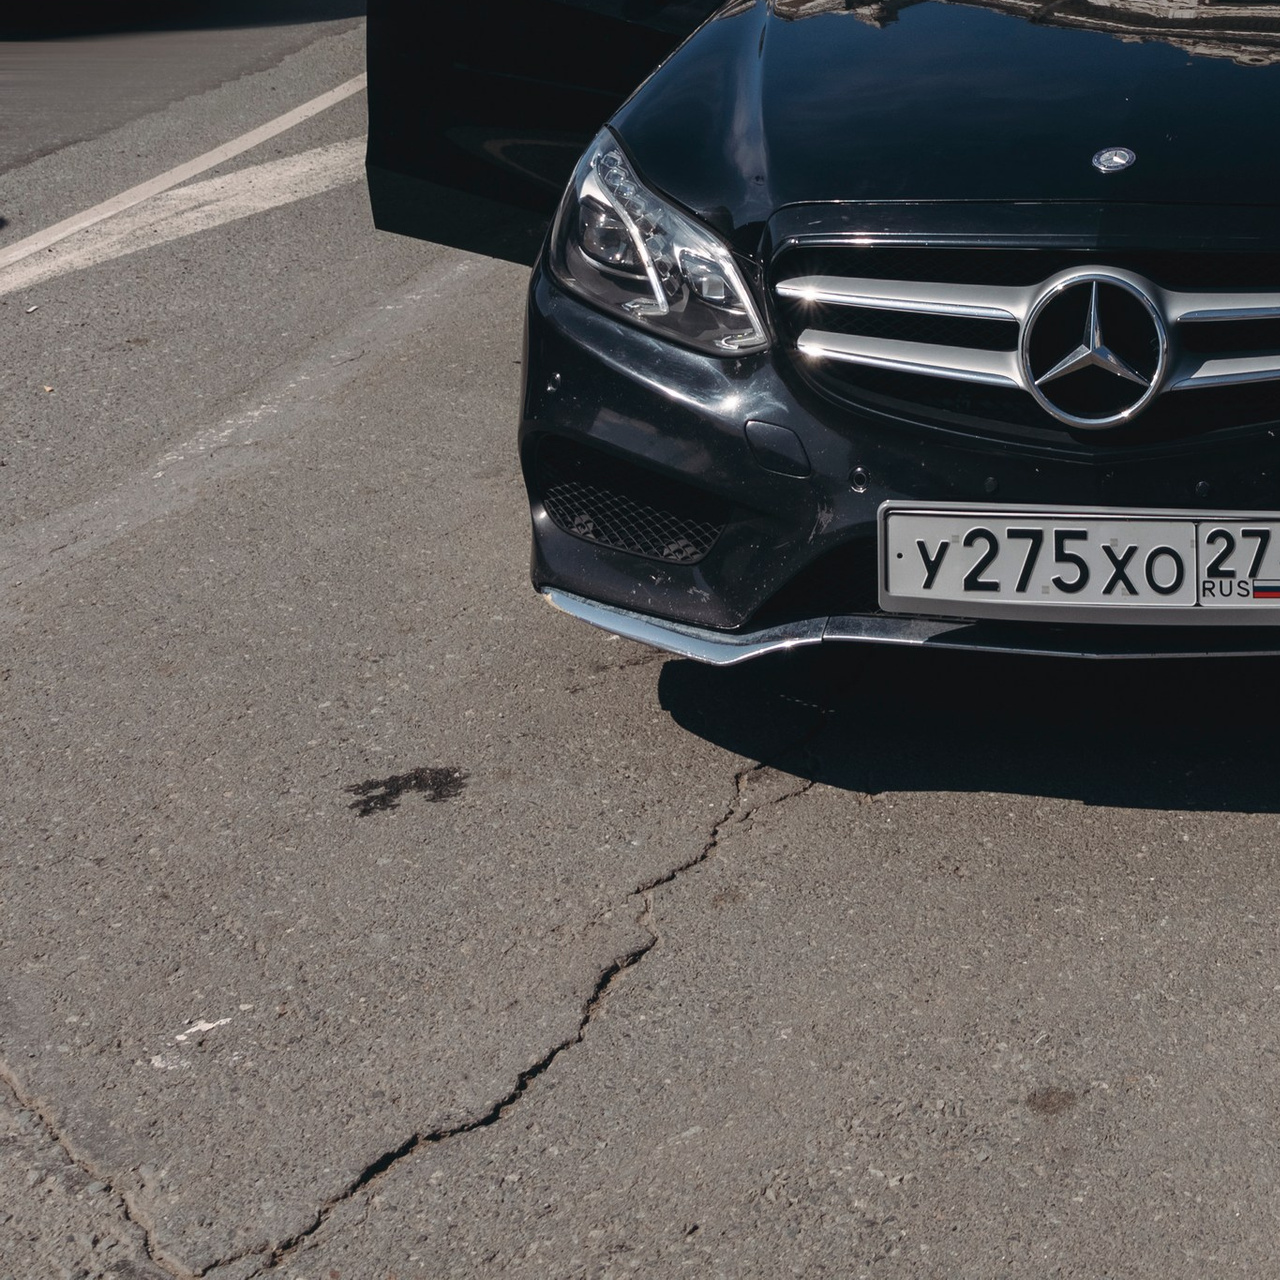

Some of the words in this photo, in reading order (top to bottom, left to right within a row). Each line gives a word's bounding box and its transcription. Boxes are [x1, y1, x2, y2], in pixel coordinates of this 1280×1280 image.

[915, 527, 1185, 596] У275ХО
[1205, 528, 1272, 579] 27
[1202, 580, 1251, 598] RUS
